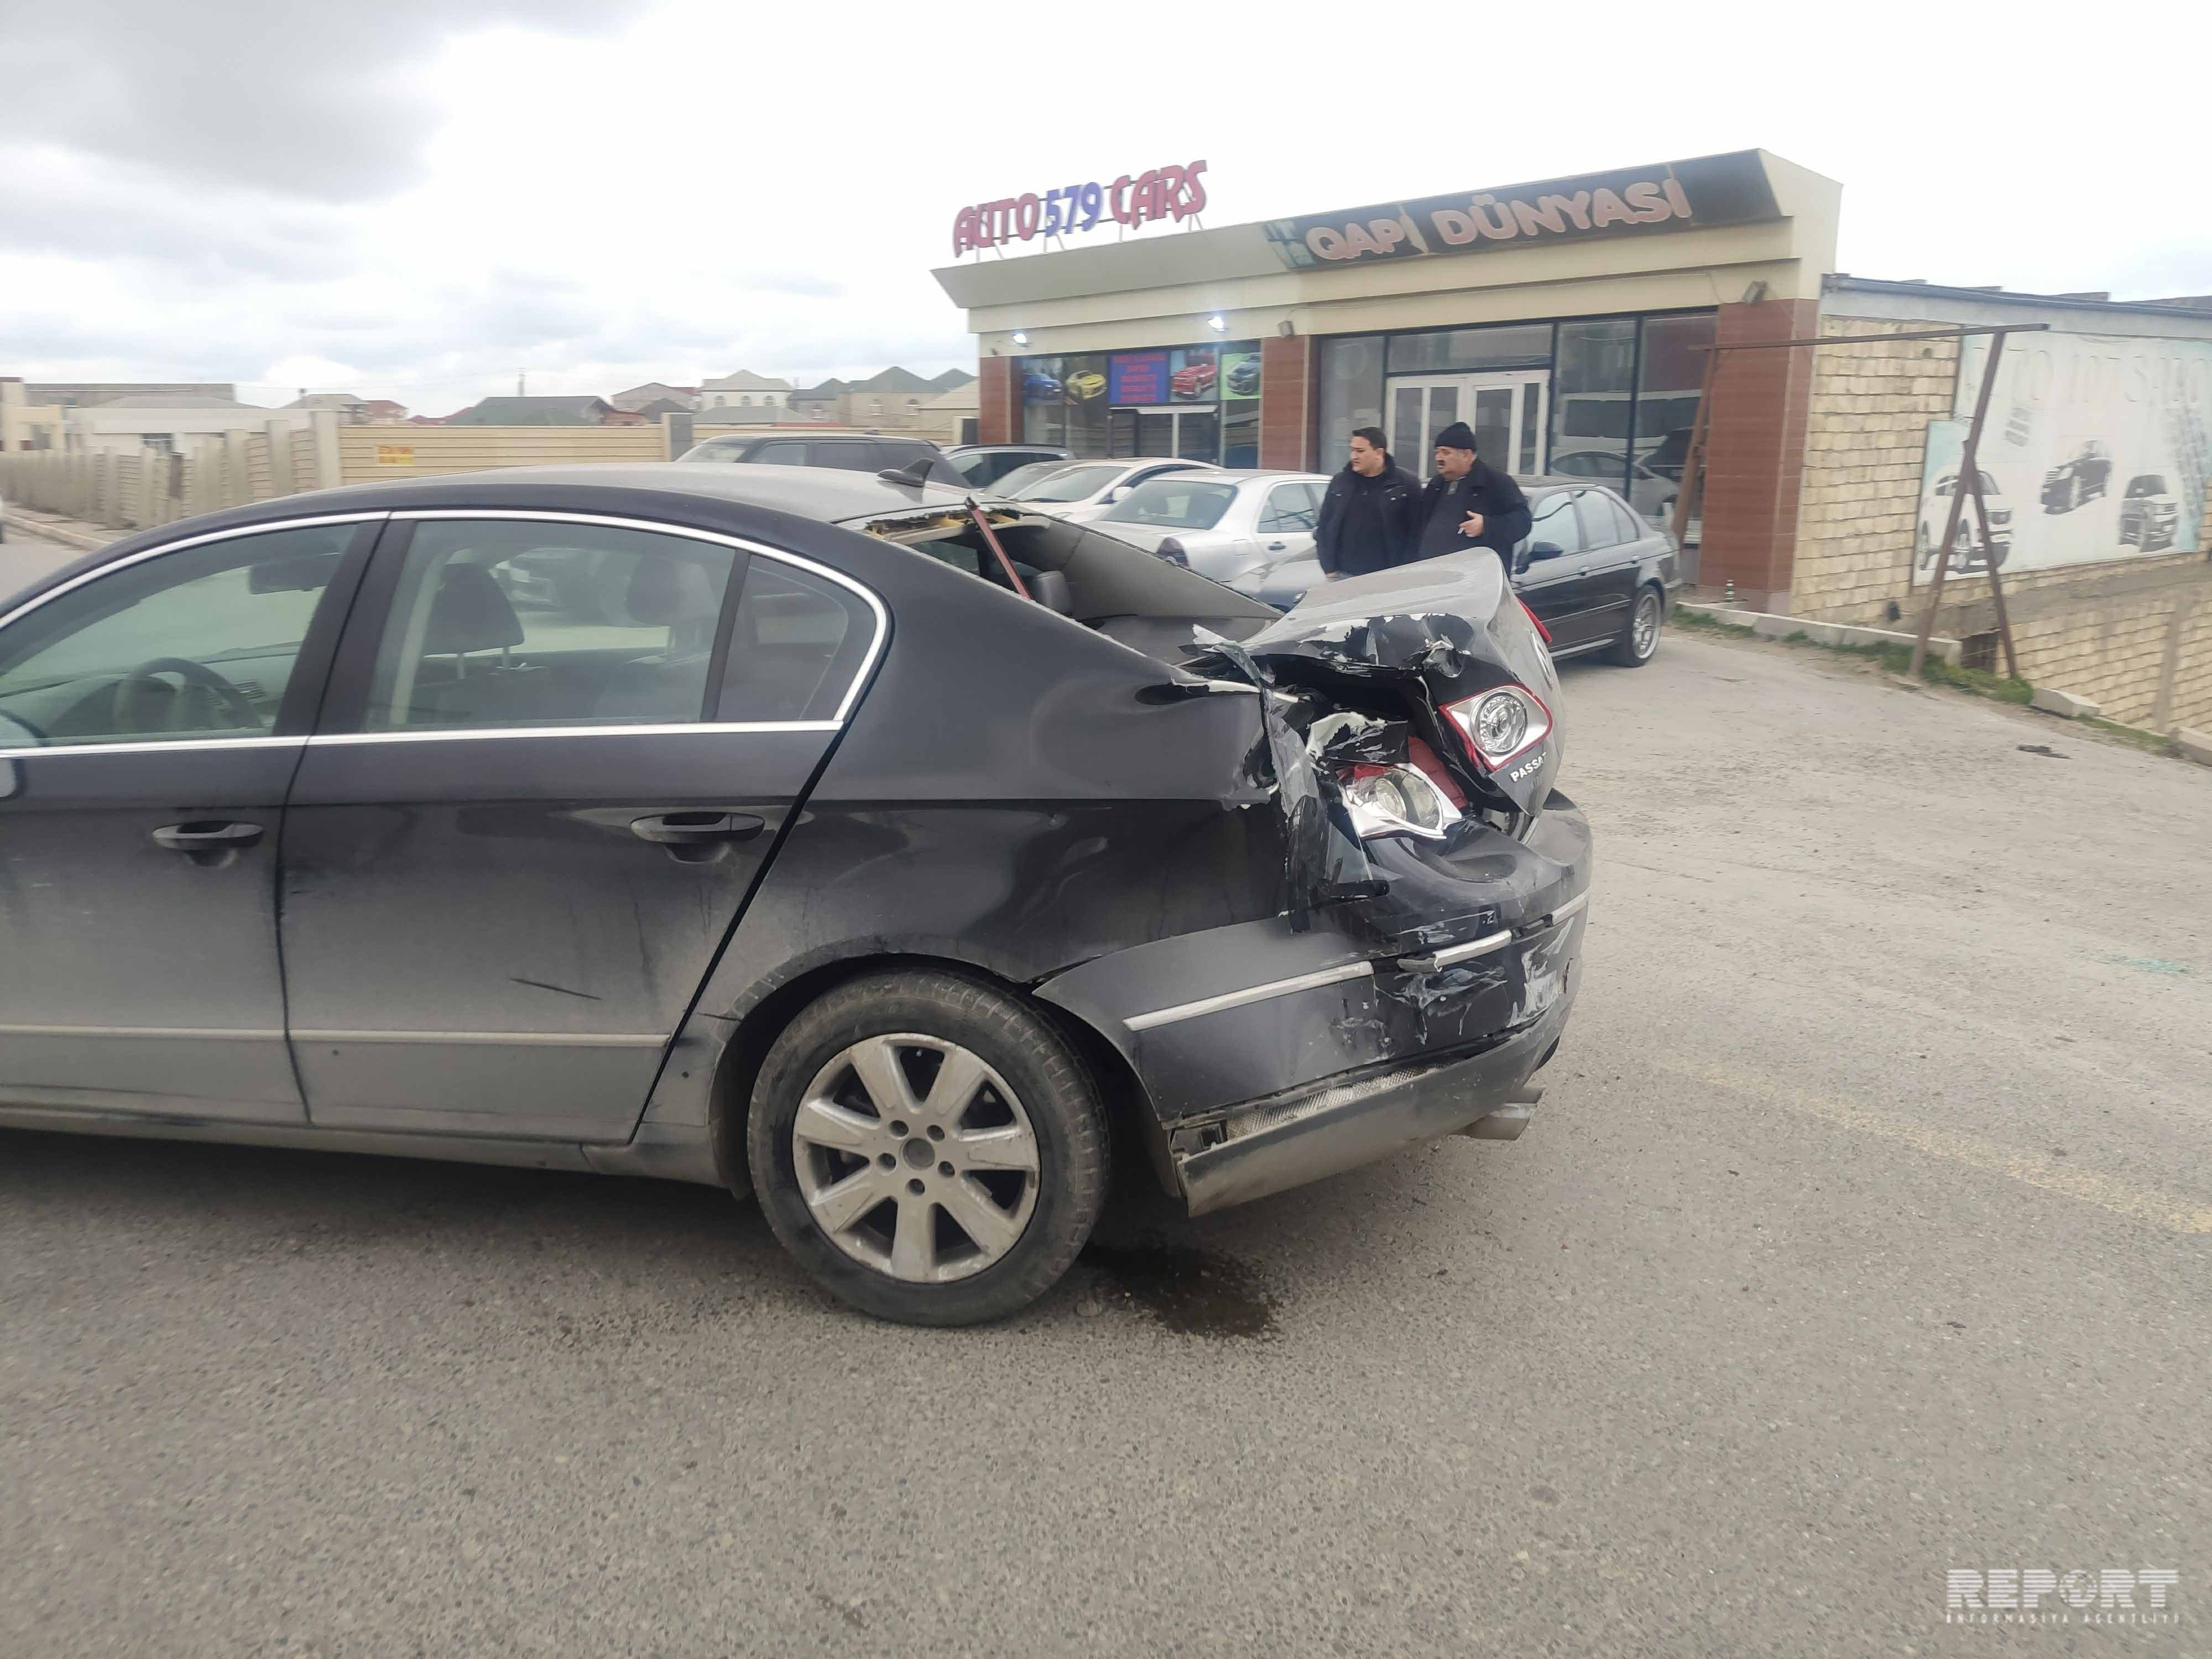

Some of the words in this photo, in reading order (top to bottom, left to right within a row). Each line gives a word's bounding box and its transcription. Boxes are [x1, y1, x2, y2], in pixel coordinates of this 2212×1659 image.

[953, 192, 1040, 258] AUTO
[1045, 182, 1102, 238] 579
[1110, 159, 1207, 230] CARS
[1431, 178, 1692, 244] DÜNYASI
